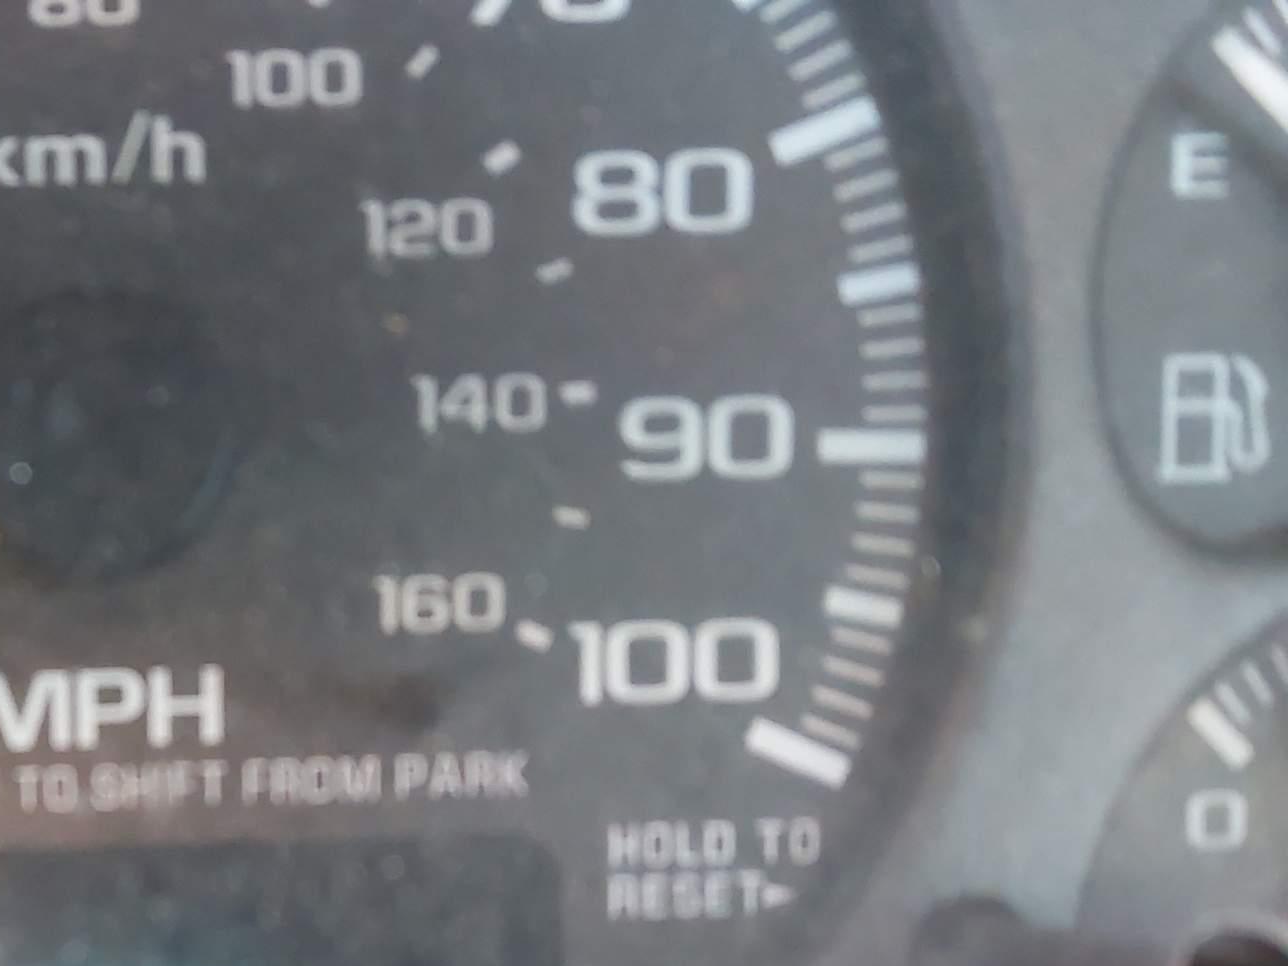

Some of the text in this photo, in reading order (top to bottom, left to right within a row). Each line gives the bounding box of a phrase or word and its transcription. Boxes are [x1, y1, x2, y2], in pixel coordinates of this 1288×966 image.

[229, 48, 361, 106] 100
[575, 149, 752, 233] 80
[1170, 133, 1228, 197] E
[364, 198, 492, 256] 120
[417, 374, 546, 431] 140
[621, 396, 793, 478] 90
[374, 573, 505, 632] 160
[573, 619, 778, 704] 100
[17, 763, 82, 814] TO
[88, 759, 225, 812] SHIFT
[241, 753, 383, 805] FROM
[394, 749, 528, 797] PARK
[608, 817, 819, 867] HOLD TO
[607, 871, 759, 918] RESET
